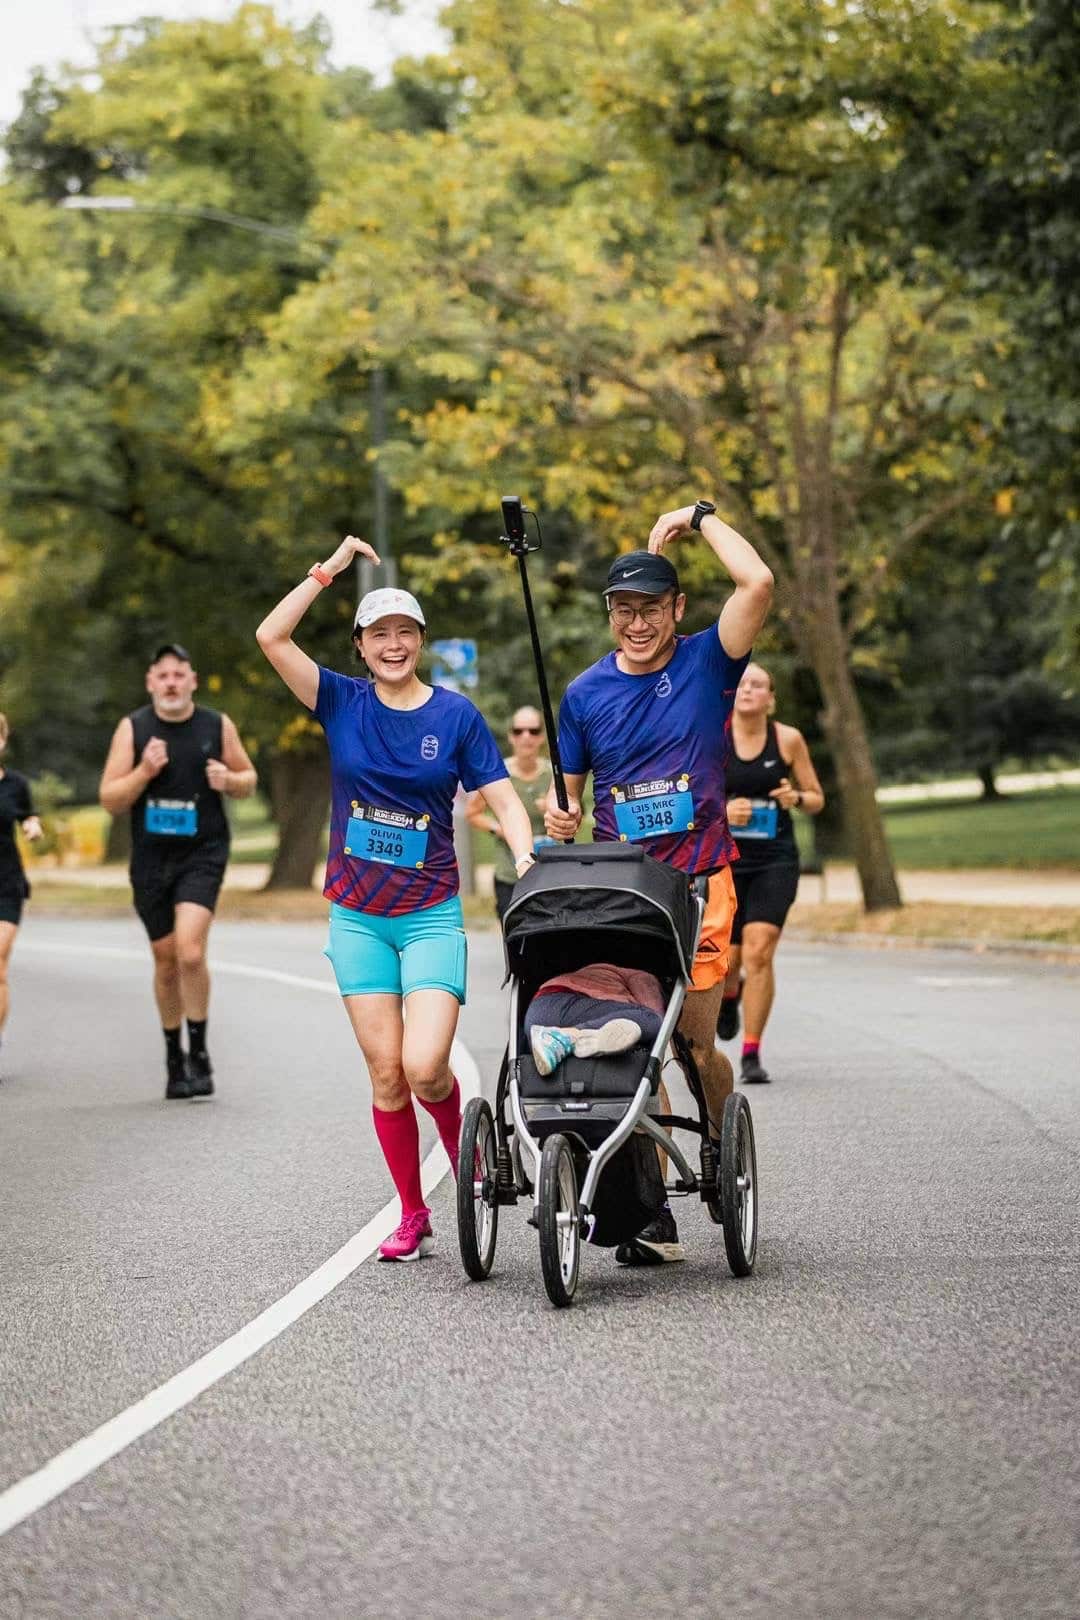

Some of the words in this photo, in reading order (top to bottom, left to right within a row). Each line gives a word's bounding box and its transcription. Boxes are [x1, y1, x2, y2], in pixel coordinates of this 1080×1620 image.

[652, 799, 676, 810] MRC
[637, 811, 673, 830] 3348
[370, 828, 402, 841] OLIVIA
[366, 839, 403, 857] 3349
